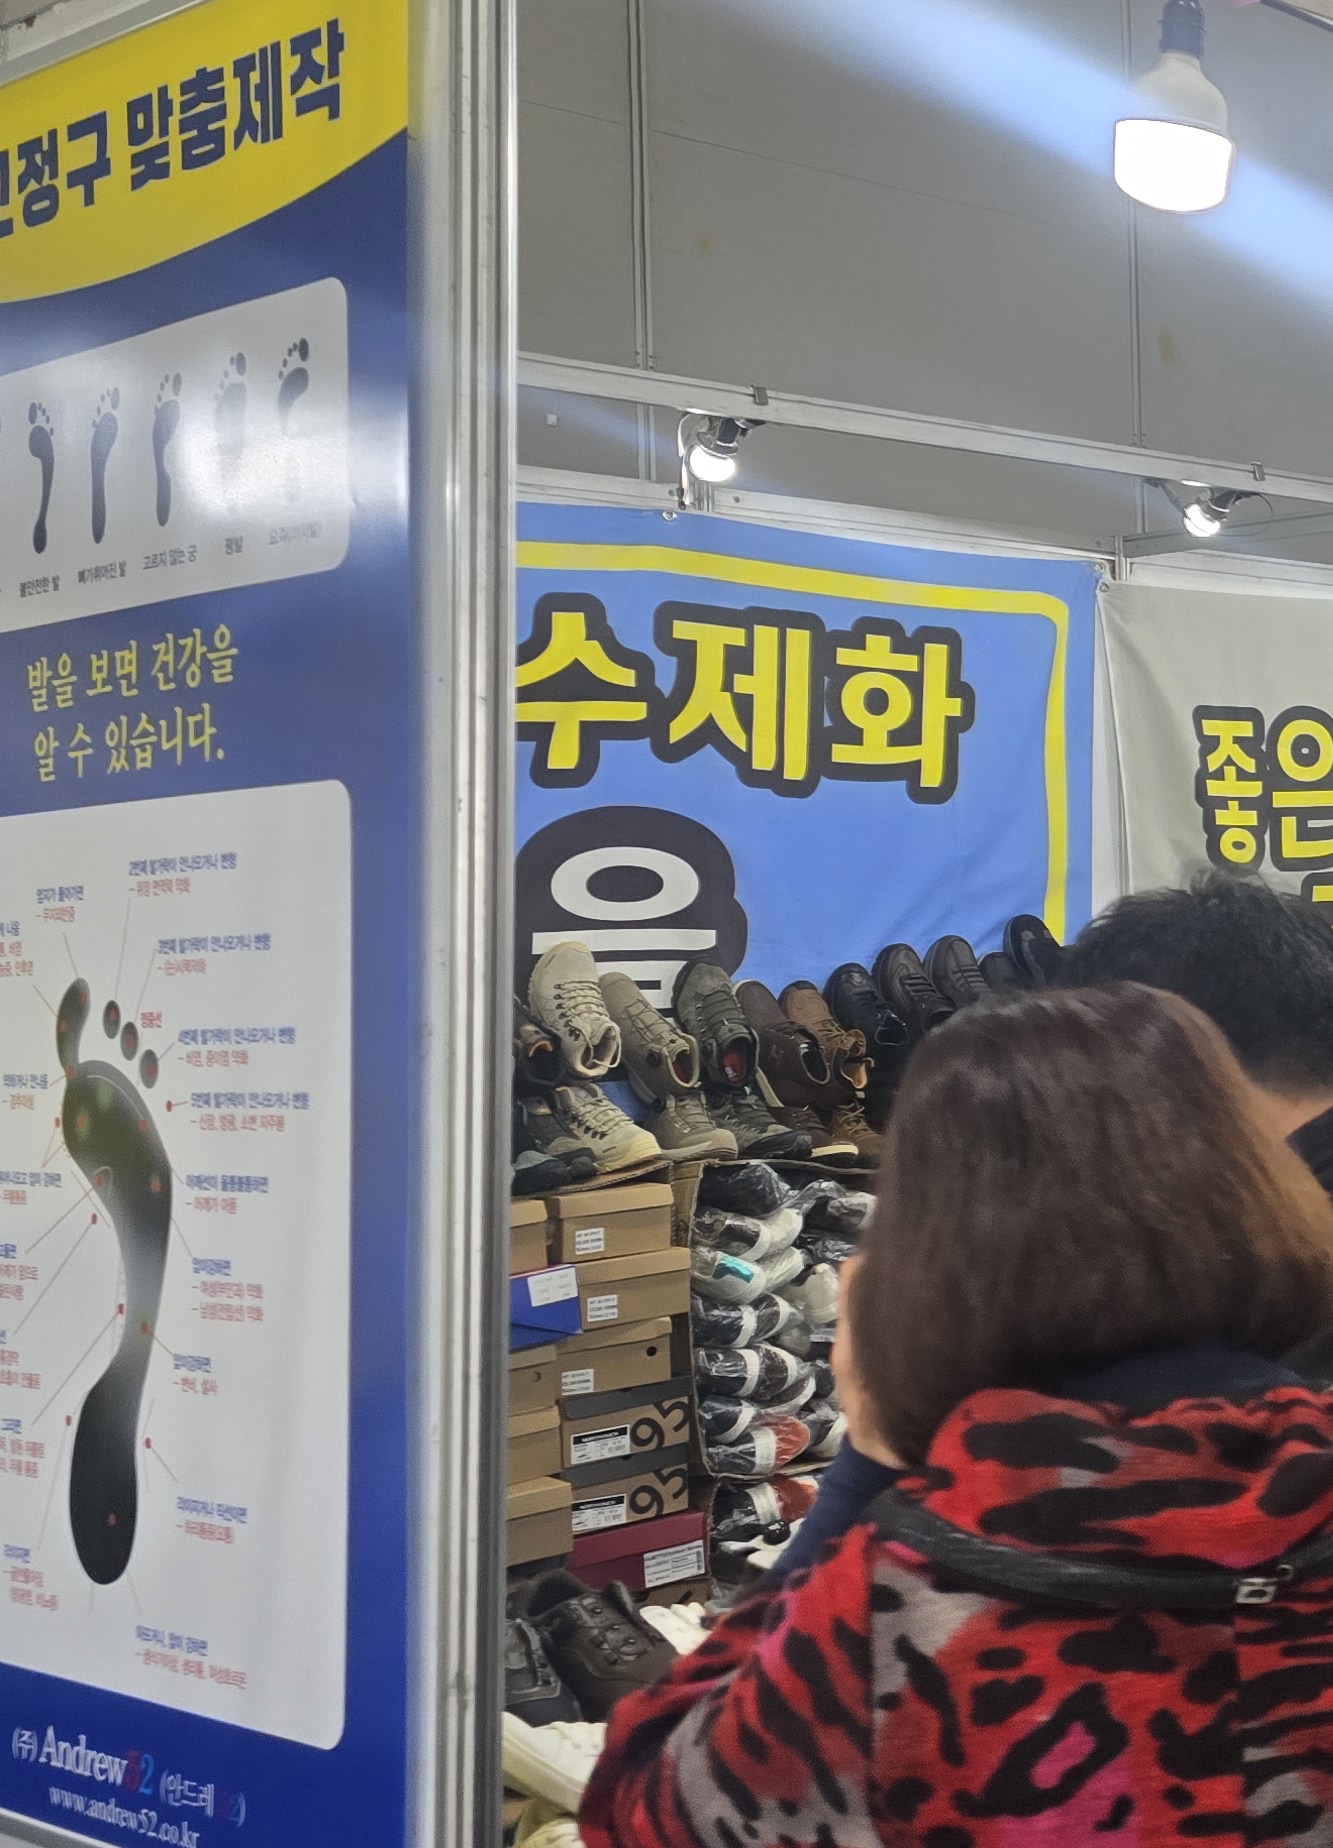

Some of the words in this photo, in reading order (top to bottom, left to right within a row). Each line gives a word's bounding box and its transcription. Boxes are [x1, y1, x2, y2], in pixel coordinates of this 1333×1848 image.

[126, 19, 345, 192] 맞춤제작
[27, 656, 78, 713] 발을
[86, 639, 139, 697] 보면
[150, 623, 240, 692] 건강을
[515, 610, 962, 788] 수제화
[34, 725, 60, 782] 알
[67, 722, 94, 778] 수
[105, 702, 226, 775] 있습니다.
